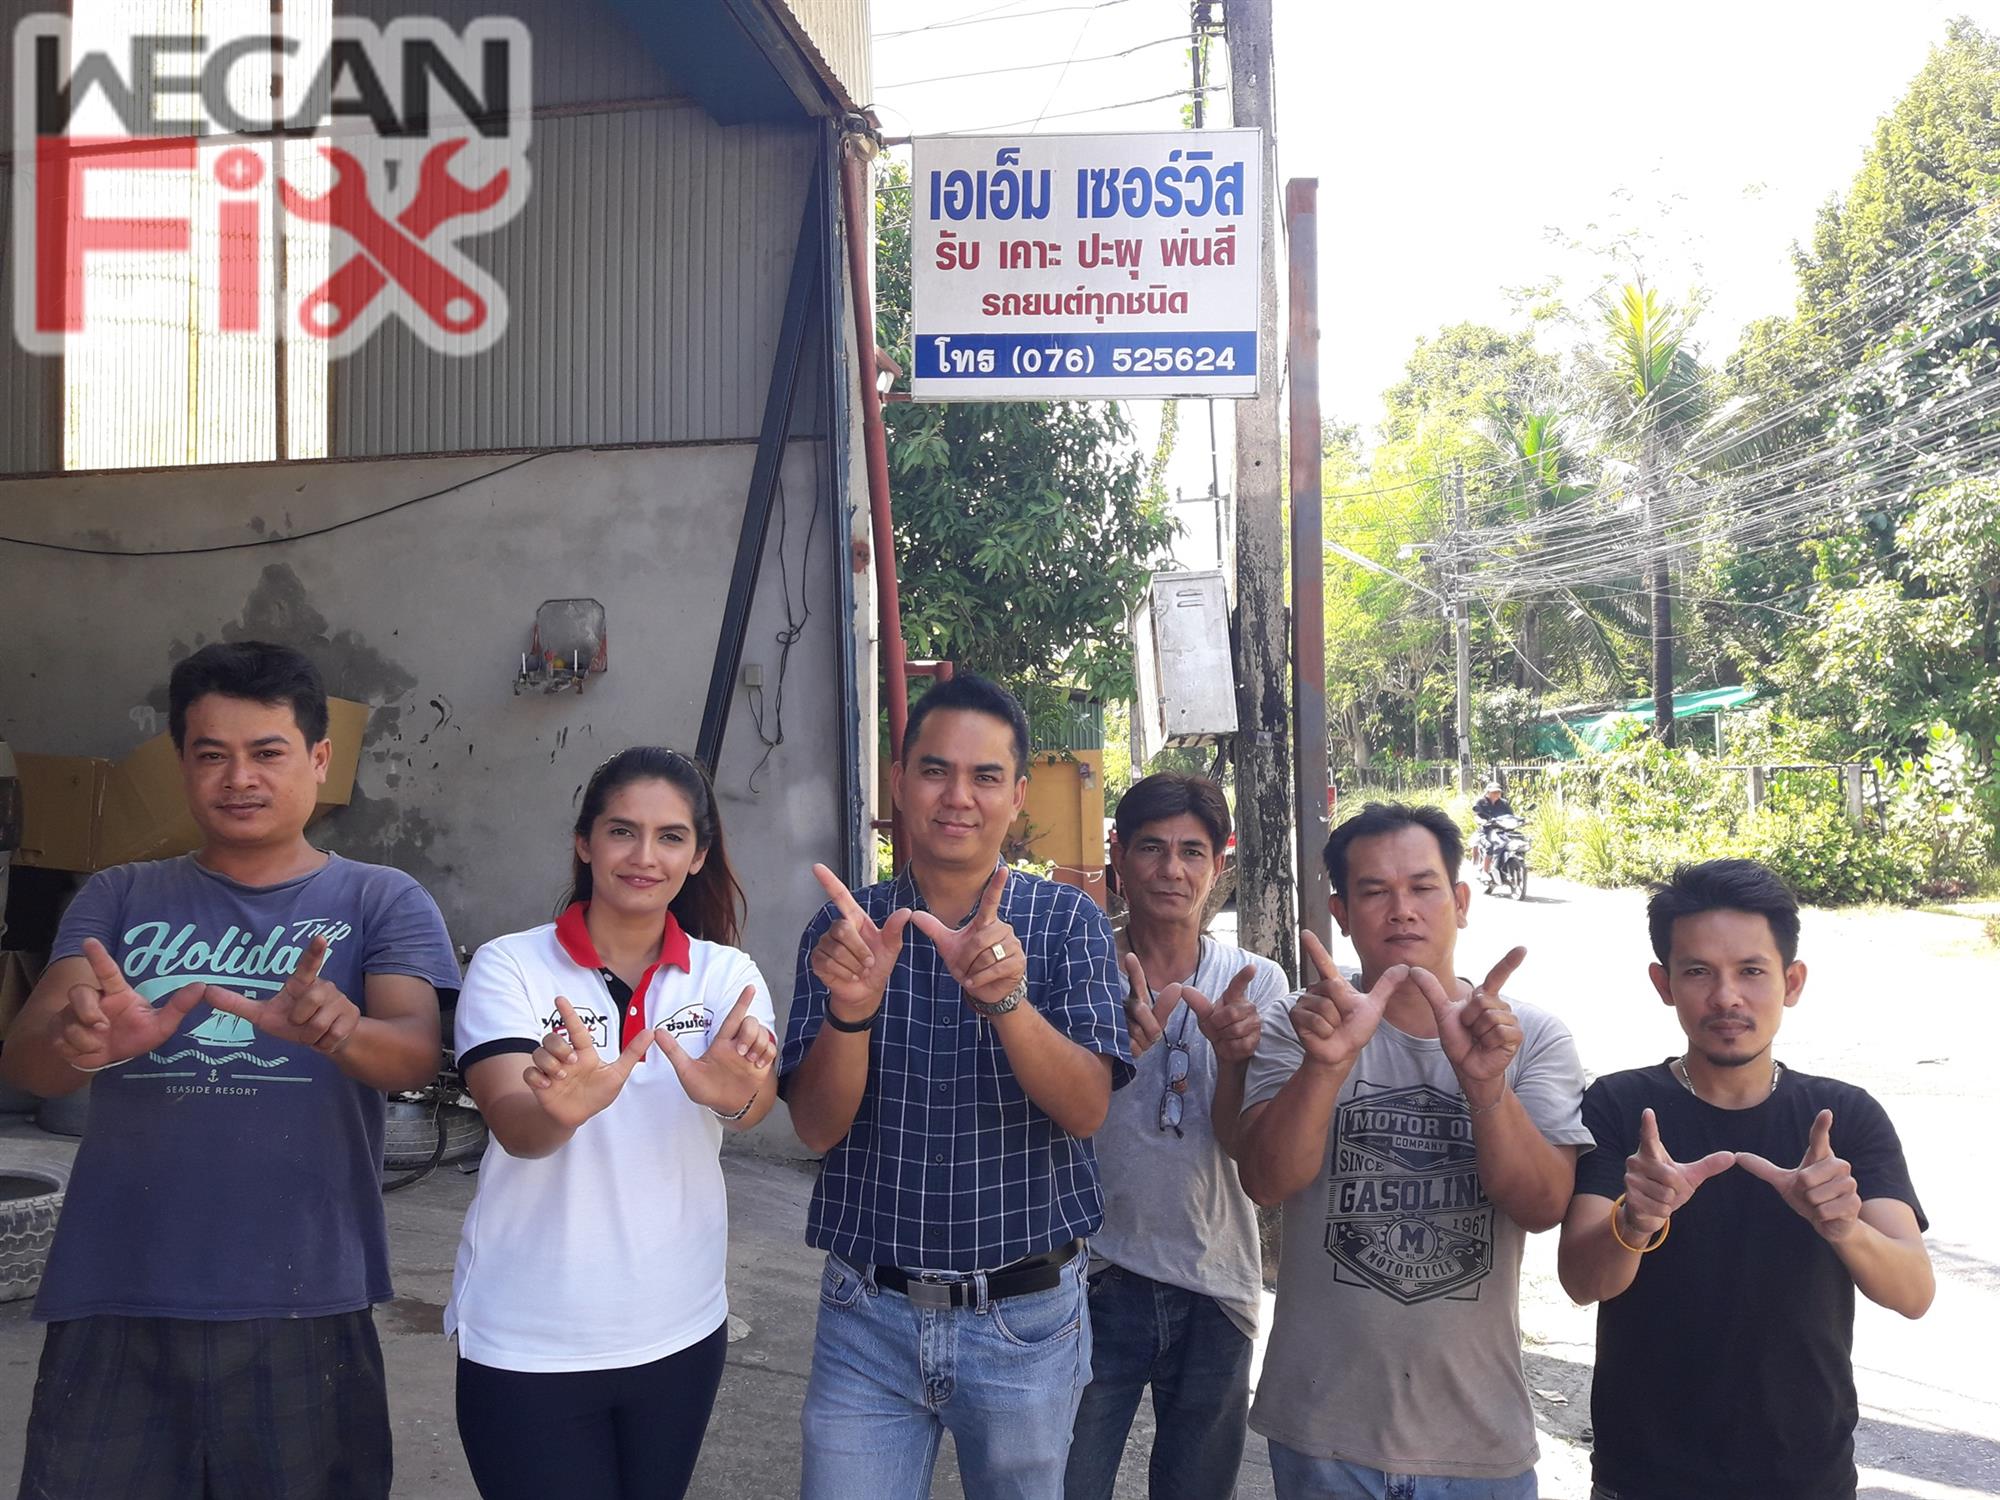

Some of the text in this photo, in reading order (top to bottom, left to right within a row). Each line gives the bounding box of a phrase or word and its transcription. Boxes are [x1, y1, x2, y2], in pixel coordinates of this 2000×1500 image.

[930, 147, 1244, 220] เอเอ็ม เซอร์วิส
[936, 225, 1236, 280] รับ เคาะ ปะผุ พ่นสี
[982, 284, 1188, 324] รถยนต์ทุกชนิด
[934, 336, 1236, 373] โทร (076) 525624
[292, 918, 352, 947] Trip
[166, 1085, 259, 1096] SEASIDE RESORT
[1352, 1112, 1473, 1141] MOTOR OI
[1395, 1136, 1445, 1151] COMPANY
[1340, 1149, 1385, 1172] SINCE
[1398, 1224, 1426, 1254] M
[1453, 1214, 1487, 1238] 1967
[1366, 1249, 1455, 1279] MOTORCYCLE
